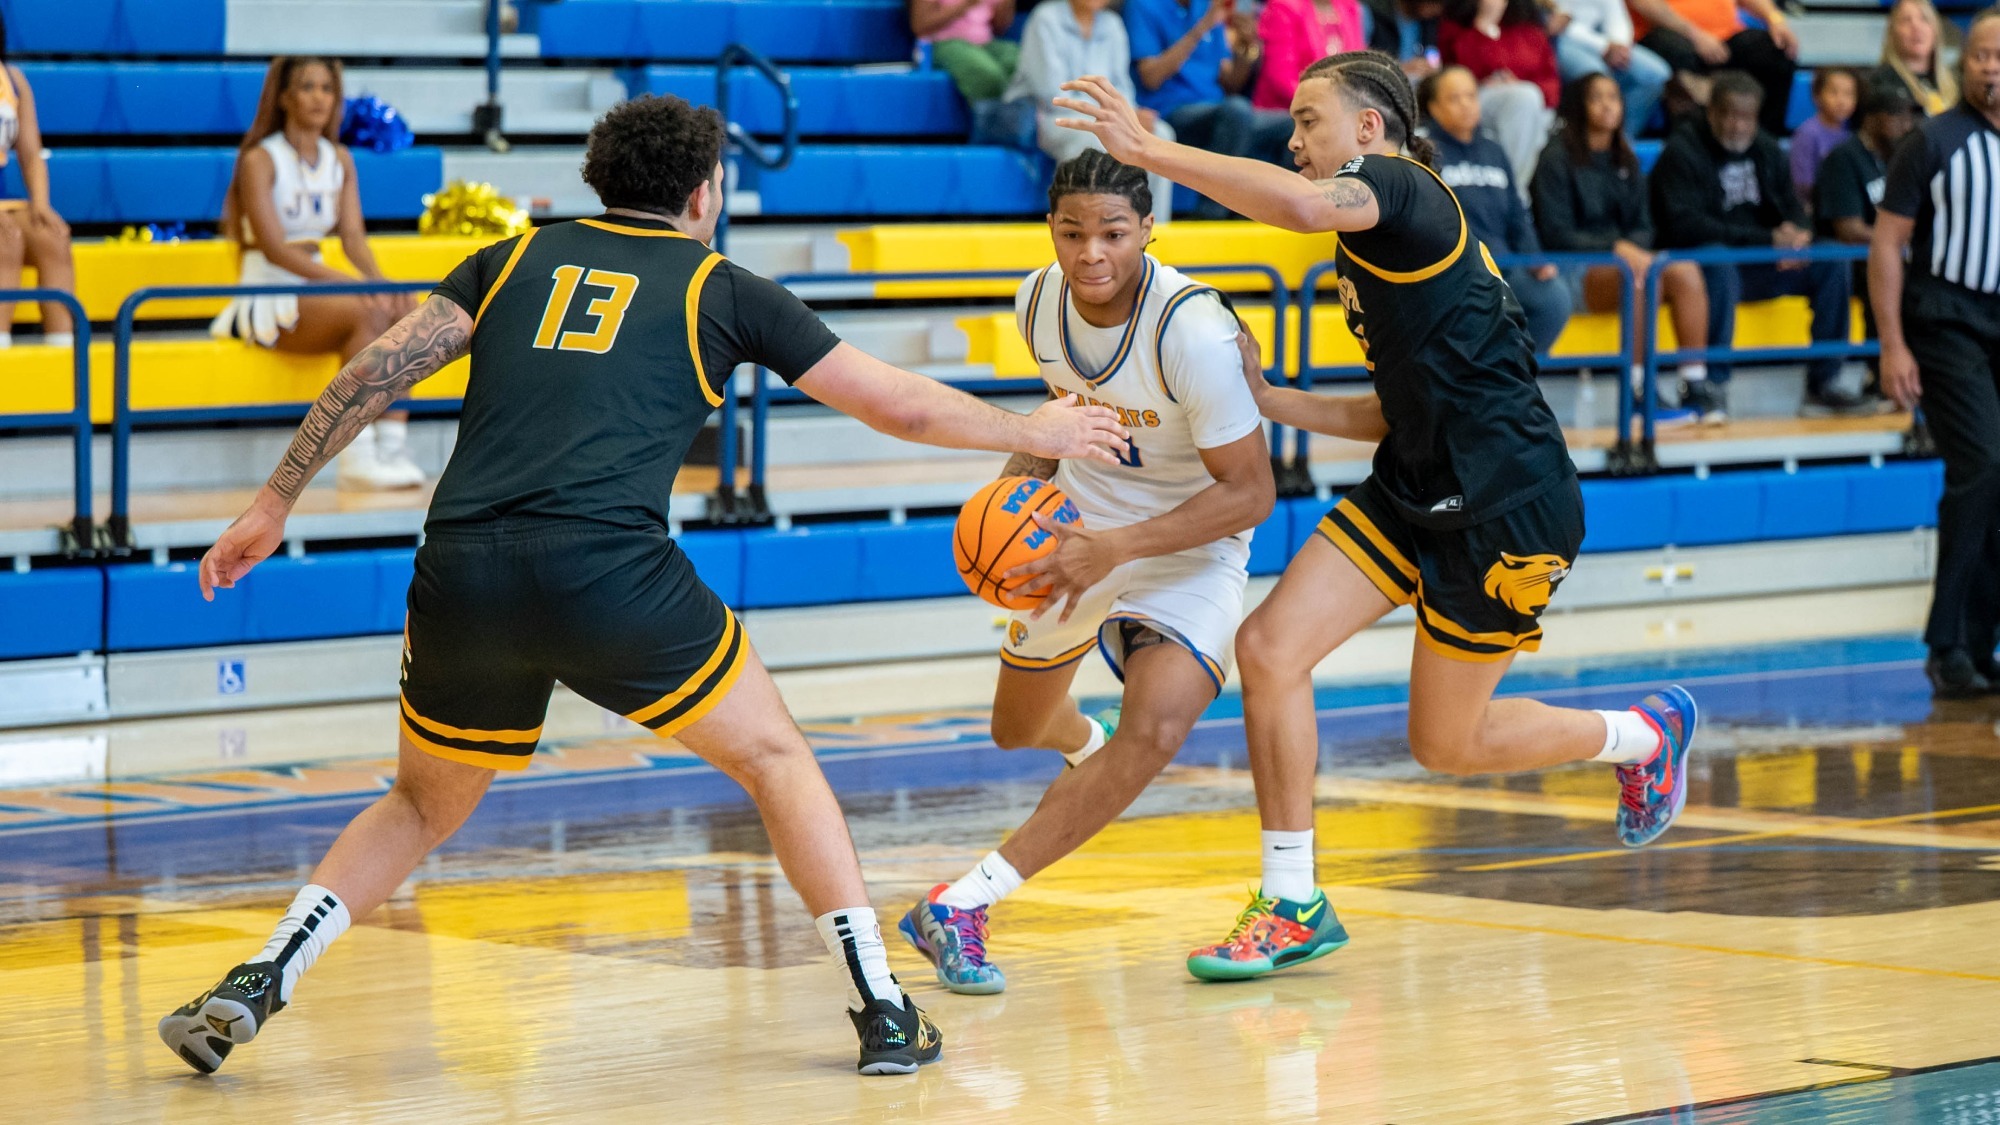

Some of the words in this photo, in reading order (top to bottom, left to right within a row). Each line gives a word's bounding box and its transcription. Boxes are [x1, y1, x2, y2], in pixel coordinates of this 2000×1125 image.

[532, 264, 640, 355] 13
[303, 402, 335, 443] FEAR
[318, 390, 344, 419] NO
[1054, 384, 1161, 428] WLATS
[289, 430, 318, 466] GOD
[268, 453, 305, 498] TRUST
[1448, 499, 1459, 507] XL
